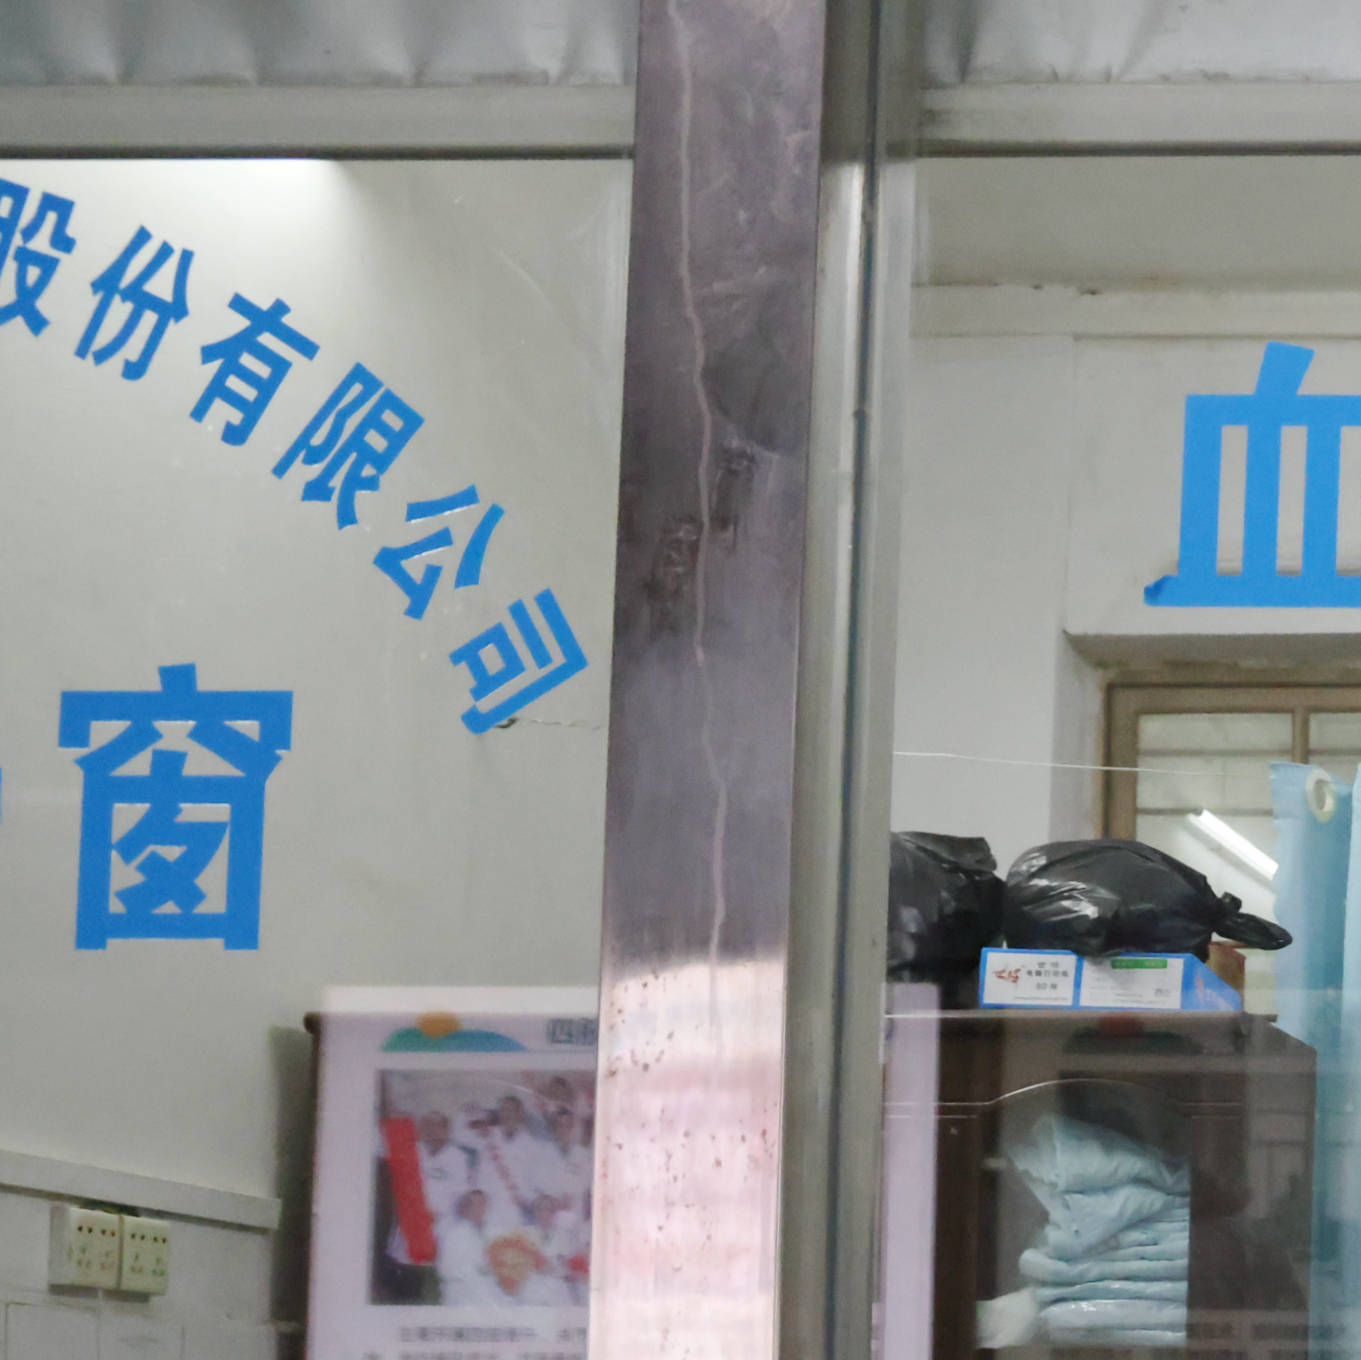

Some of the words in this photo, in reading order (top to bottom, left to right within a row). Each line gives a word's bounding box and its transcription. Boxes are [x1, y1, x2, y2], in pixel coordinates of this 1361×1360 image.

[0, 178, 588, 735] 股份有限公司
[57, 662, 294, 951] 窗
